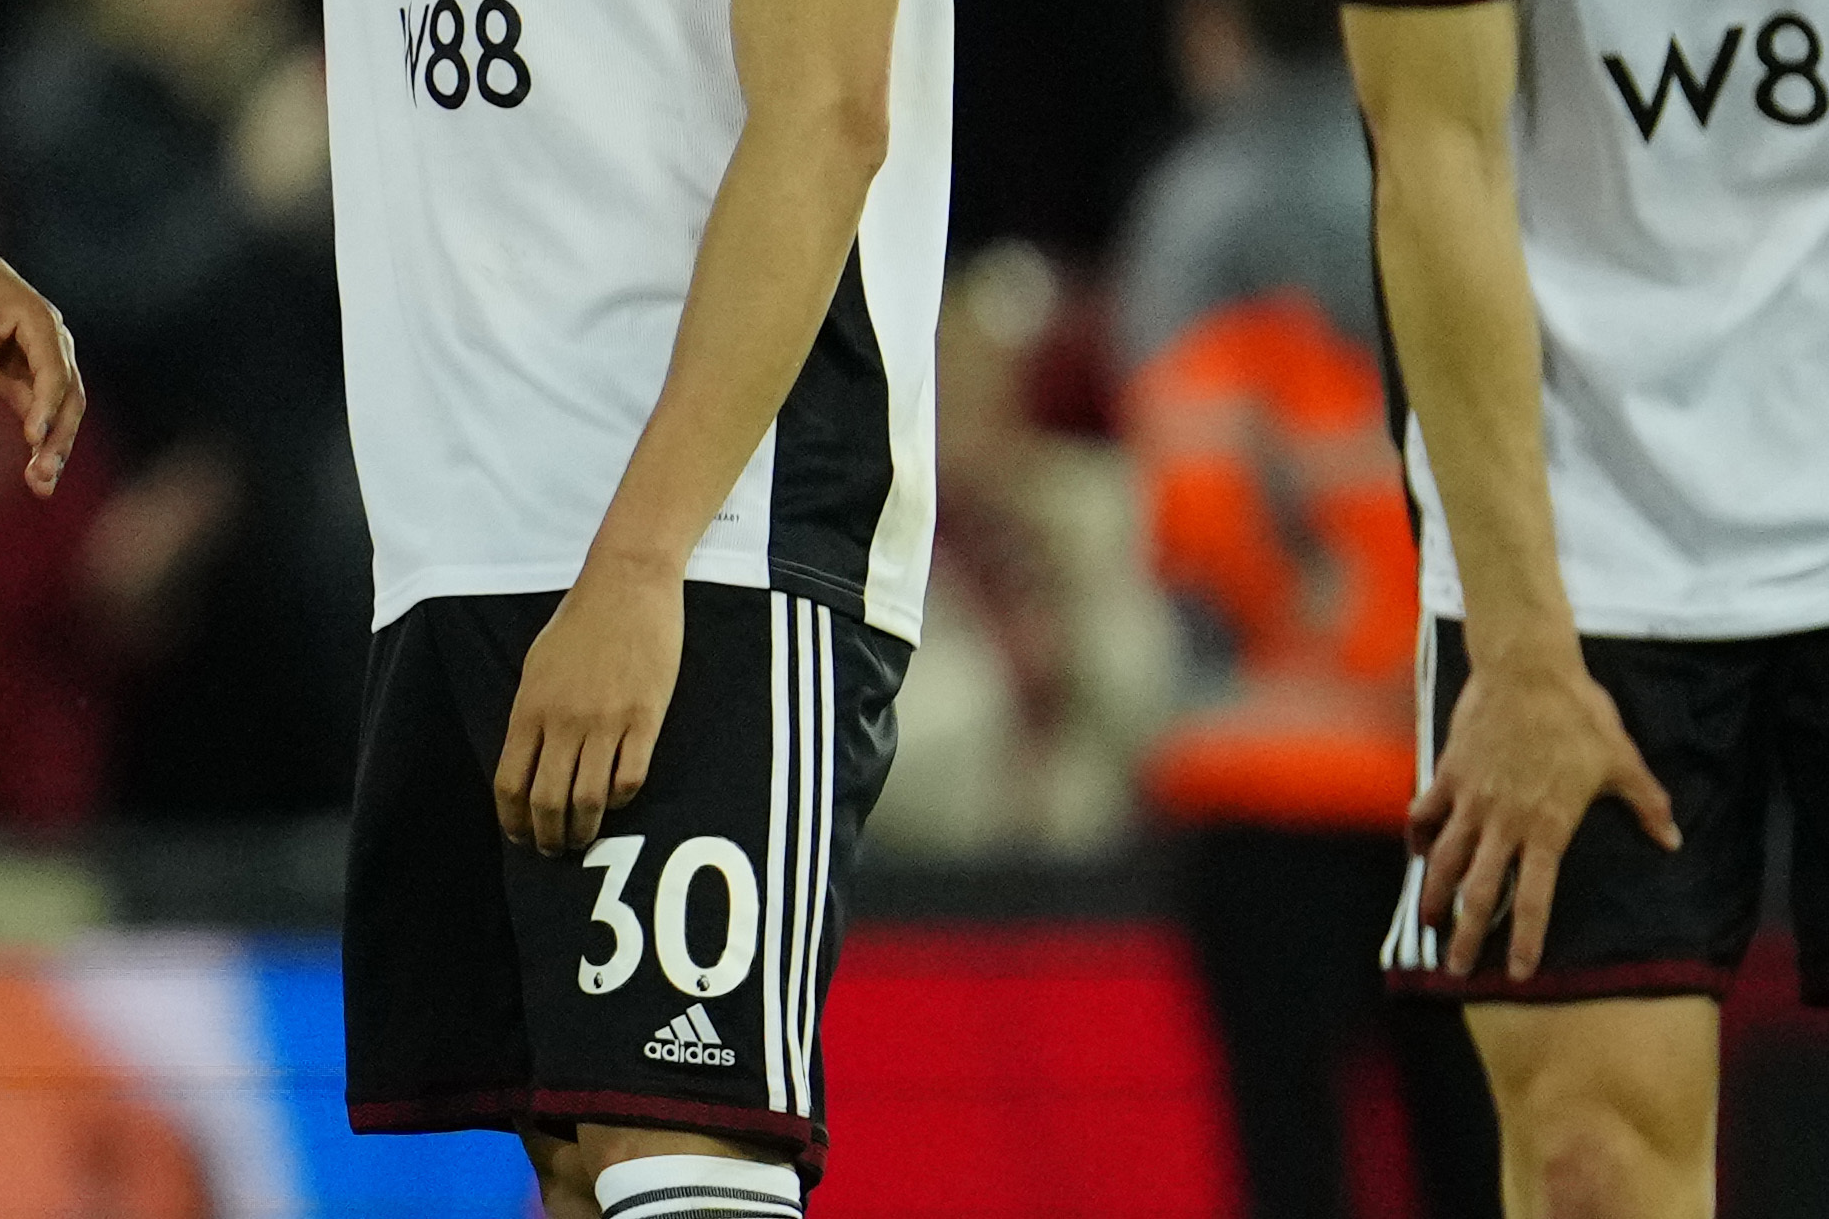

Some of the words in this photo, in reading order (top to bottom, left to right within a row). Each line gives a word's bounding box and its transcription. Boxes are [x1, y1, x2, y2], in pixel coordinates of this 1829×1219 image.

[1603, 10, 1828, 142] W8
[577, 834, 760, 998] 30
[643, 1038, 736, 1067] adidas
